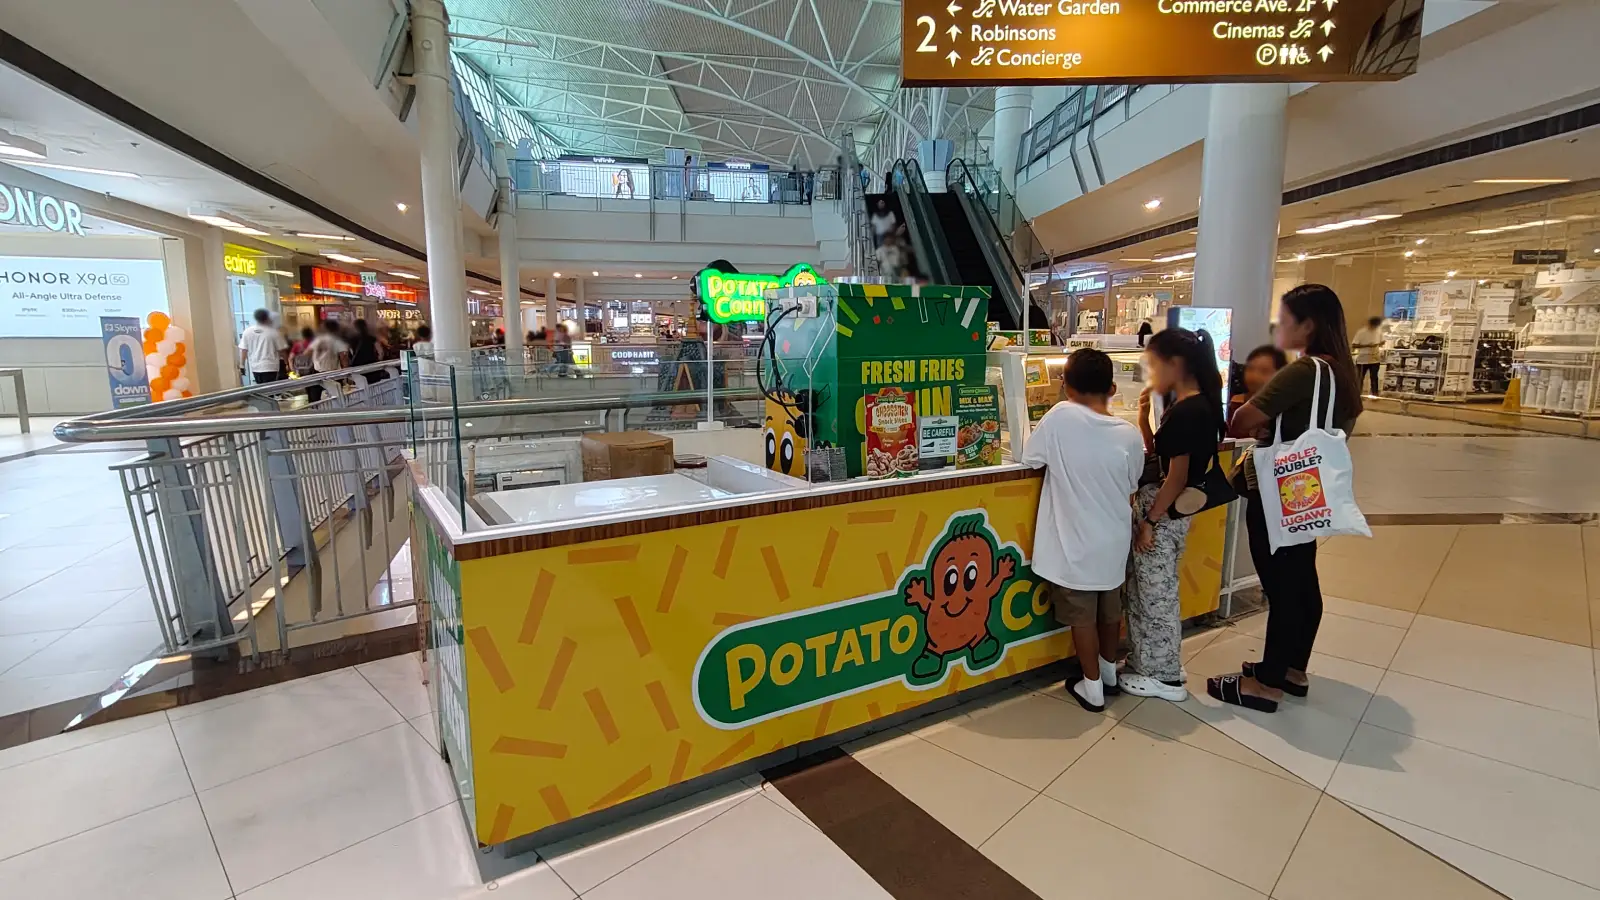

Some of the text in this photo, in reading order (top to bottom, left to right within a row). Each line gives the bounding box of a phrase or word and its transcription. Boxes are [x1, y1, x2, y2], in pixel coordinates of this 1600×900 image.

[1000, 0, 1119, 17] Water Garden
[1158, 0, 1316, 14] Commerce Ave. 2F
[916, 16, 938, 53] 2
[971, 25, 1056, 41] Robinsons
[1213, 22, 1284, 39] Cinemas
[997, 49, 1082, 69] Concierge
[0, 184, 86, 237] ONOR
[224, 254, 256, 275] ealme
[0, 271, 126, 285] HONOR X9d 5G
[12, 292, 122, 302] All-Angle Ultra Defense
[714, 296, 765, 318] CORN
[114, 324, 138, 334] Skyro
[106, 335, 146, 382] 0
[862, 358, 965, 384] FRESH FRIES
[114, 384, 148, 395] down
[923, 428, 955, 438] BE CAREFUL
[1274, 455, 1322, 476] DOUBLE?
[1281, 508, 1332, 527] LUGAW?
[1288, 519, 1331, 533] GOTO?
[725, 615, 918, 711] POTATO
